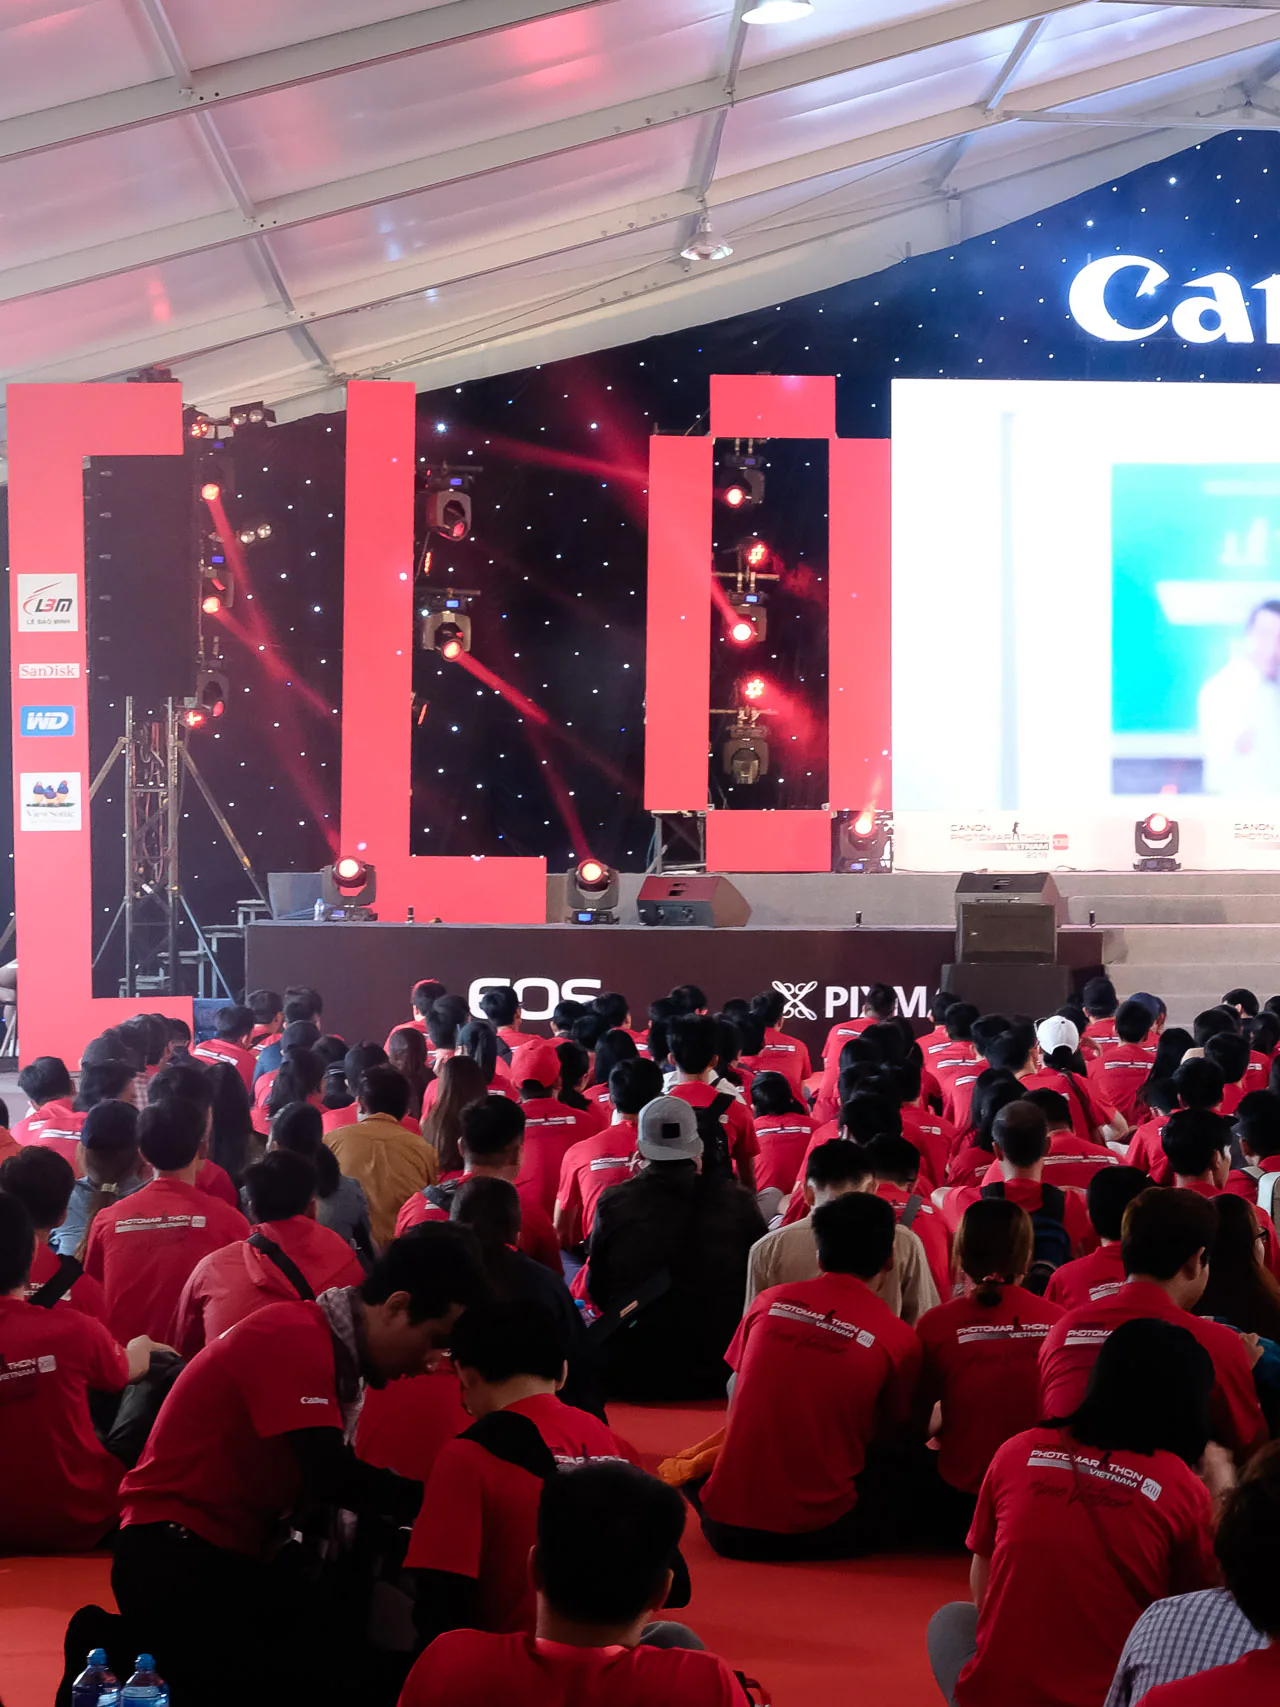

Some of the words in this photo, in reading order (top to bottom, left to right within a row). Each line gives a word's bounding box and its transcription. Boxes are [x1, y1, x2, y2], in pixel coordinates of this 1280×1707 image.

[21, 664, 76, 677] SanDisk
[26, 712, 69, 731] WD
[950, 824, 991, 832] CANON
[1089, 1468, 1138, 1488] VIETNAM
[1108, 1463, 1144, 1481] THON
